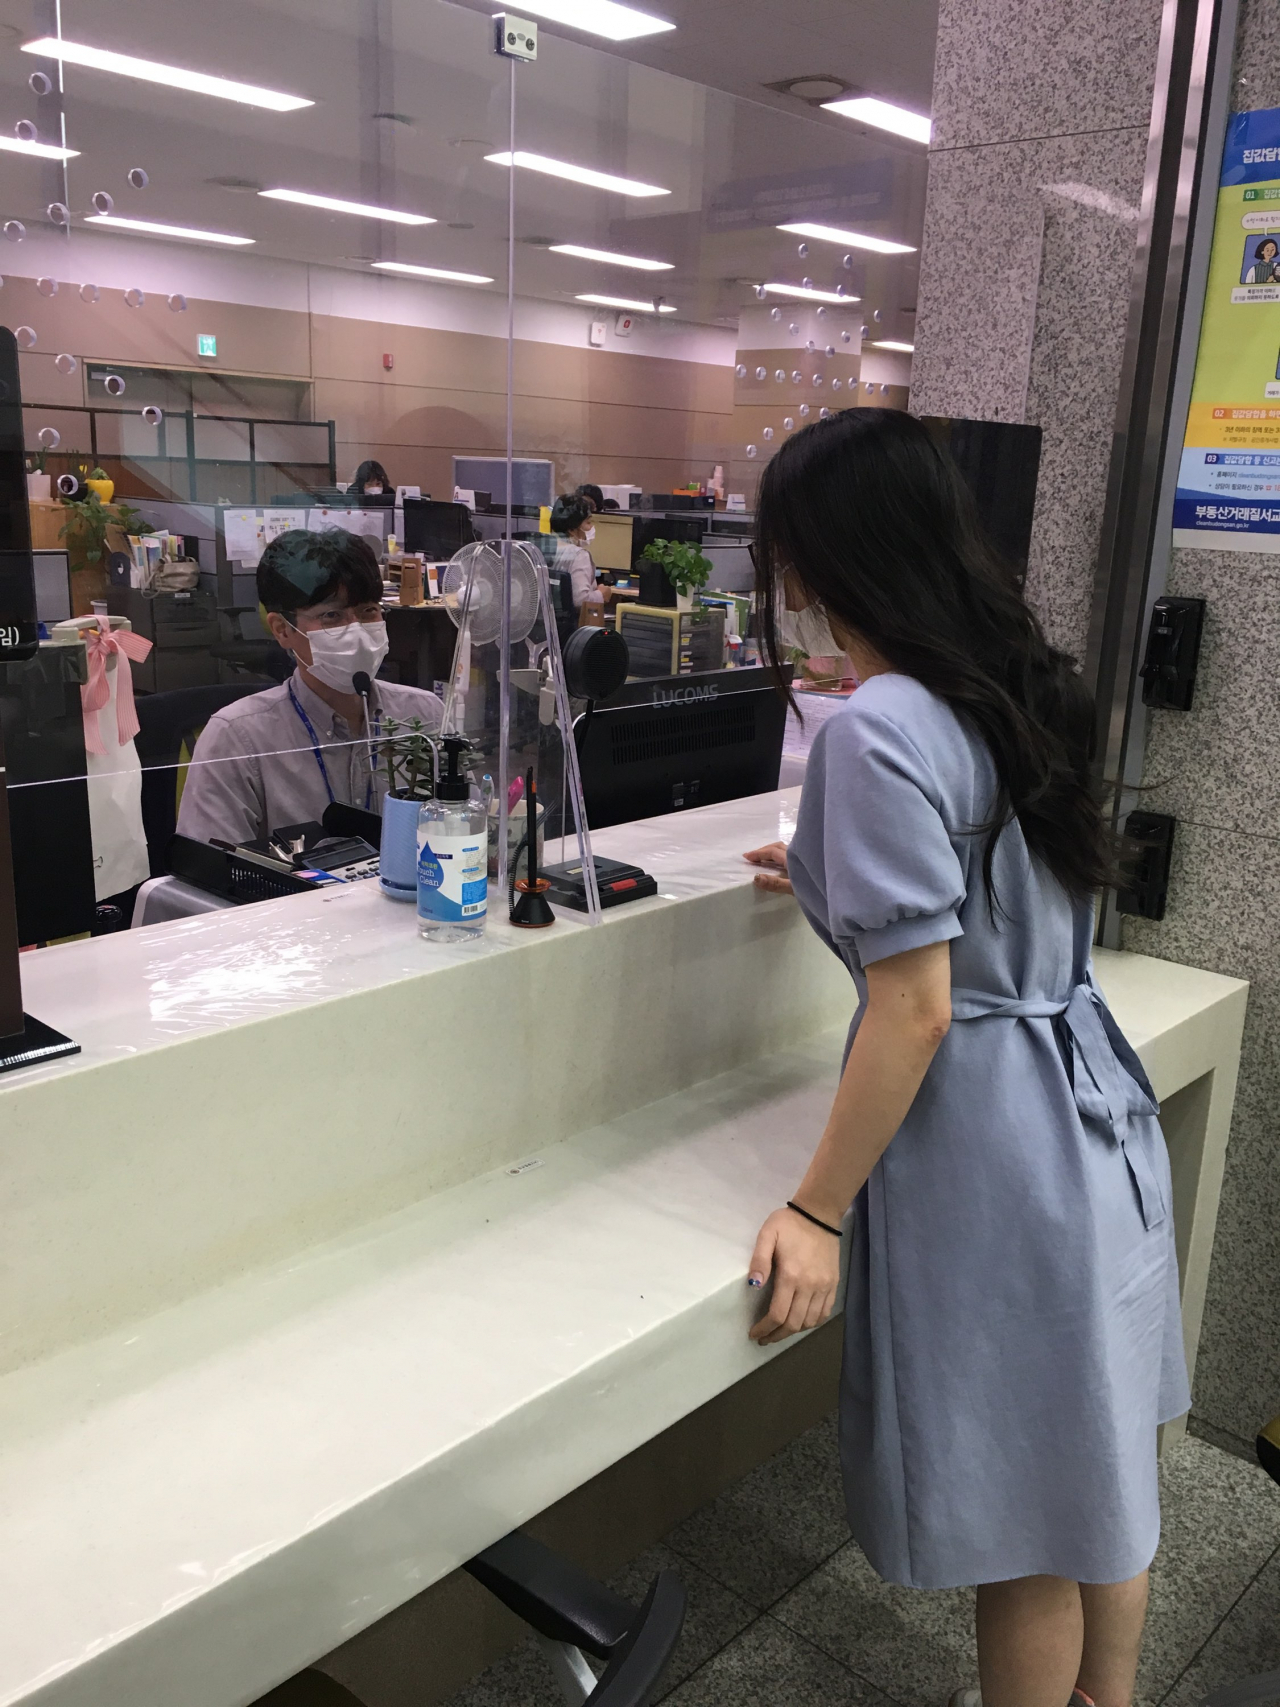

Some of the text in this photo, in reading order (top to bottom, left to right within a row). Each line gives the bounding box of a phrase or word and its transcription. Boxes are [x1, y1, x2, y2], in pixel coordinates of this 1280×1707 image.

[1245, 189, 1280, 199] 01 집값
[1214, 410, 1225, 418] 02
[1232, 410, 1266, 419] 집값담합을
[1207, 455, 1217, 463] 03
[1225, 455, 1252, 465] 집값담합
[1254, 456, 1261, 465] 등
[652, 683, 719, 709] LUCOMS
[419, 875, 440, 887] Clean
